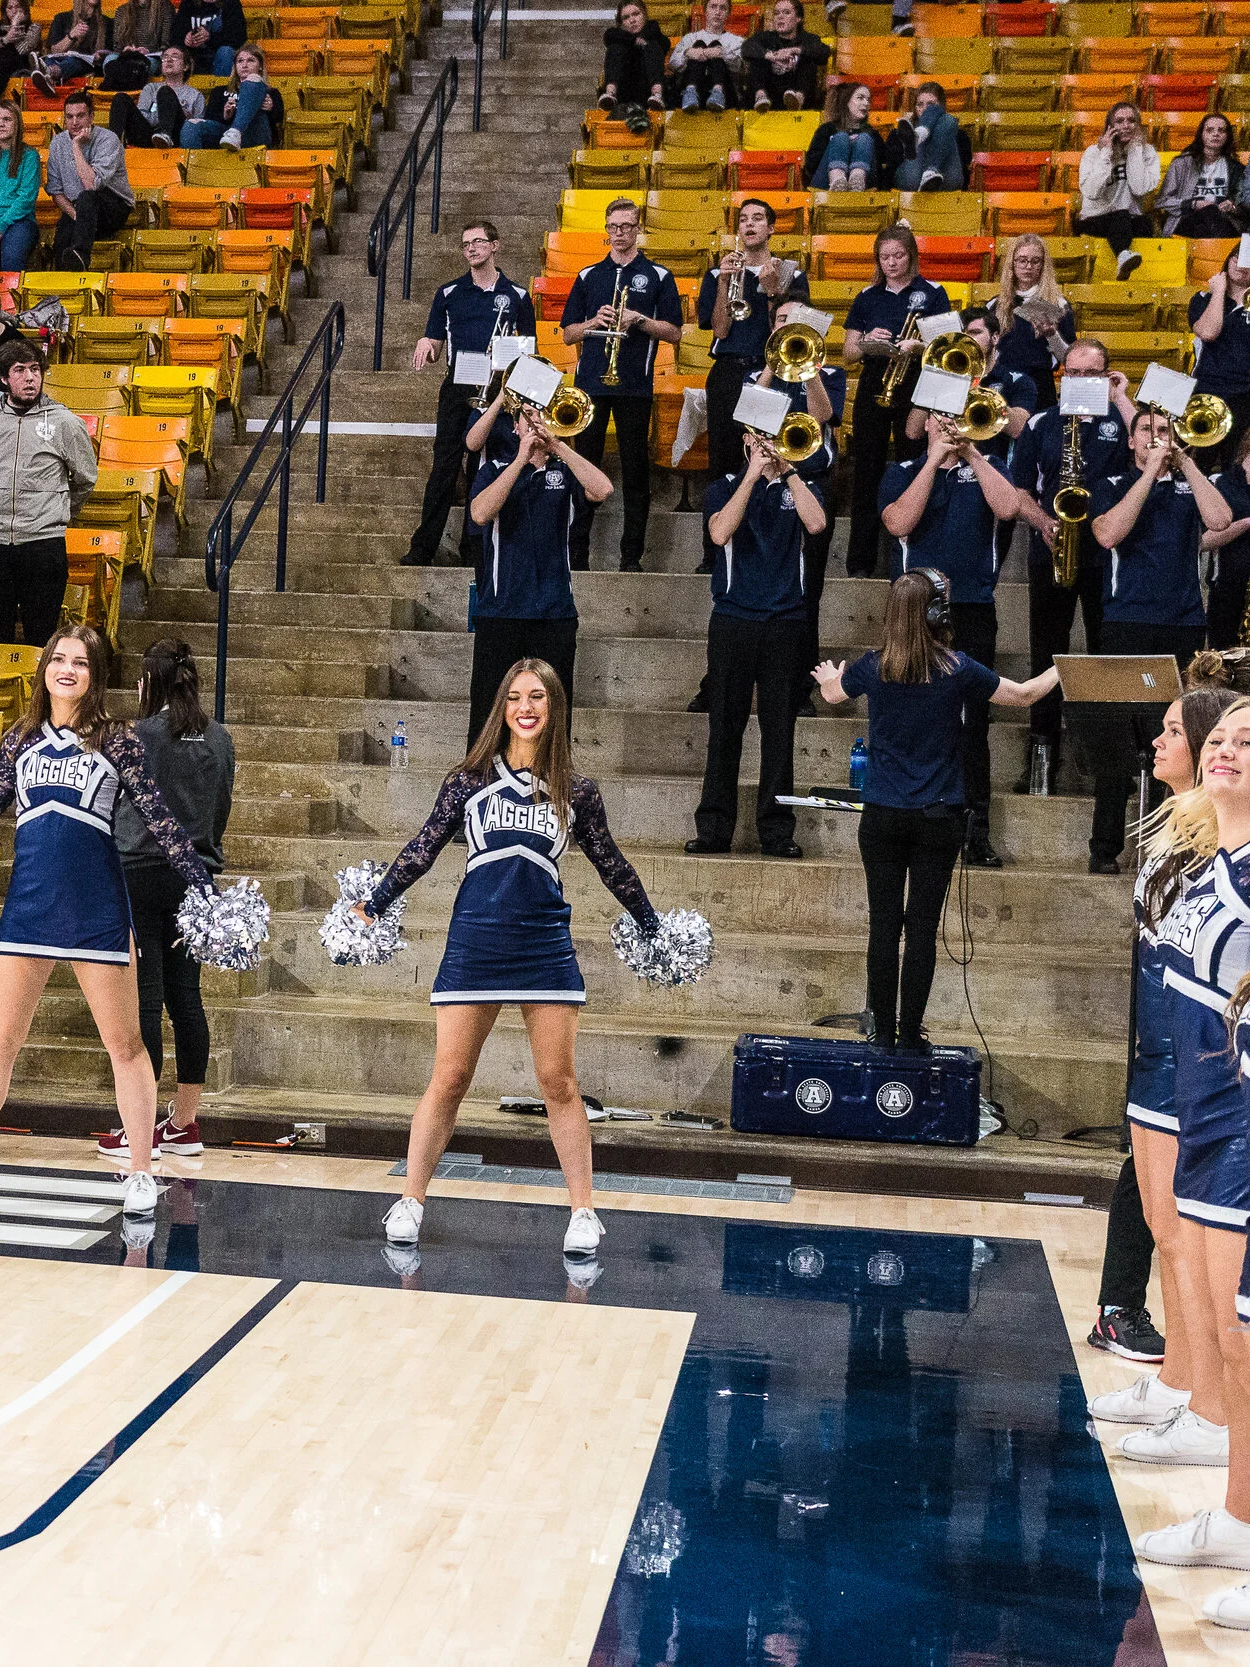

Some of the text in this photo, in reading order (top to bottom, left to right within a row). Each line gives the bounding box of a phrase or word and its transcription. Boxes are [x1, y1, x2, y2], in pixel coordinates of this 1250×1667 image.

[78, 277, 86, 285] 17
[134, 323, 143, 331] 18
[215, 324, 224, 332] 19
[103, 371, 111, 379] 18
[188, 373, 196, 382] 19
[158, 423, 167, 432] 19
[125, 477, 134, 486] 19
[91, 536, 100, 546] 19
[9, 652, 19, 663] 19
[22, 751, 93, 790] AGGIES
[483, 793, 559, 841] AGGIES
[805, 1087, 823, 1104] A
[886, 1090, 904, 1107] A
